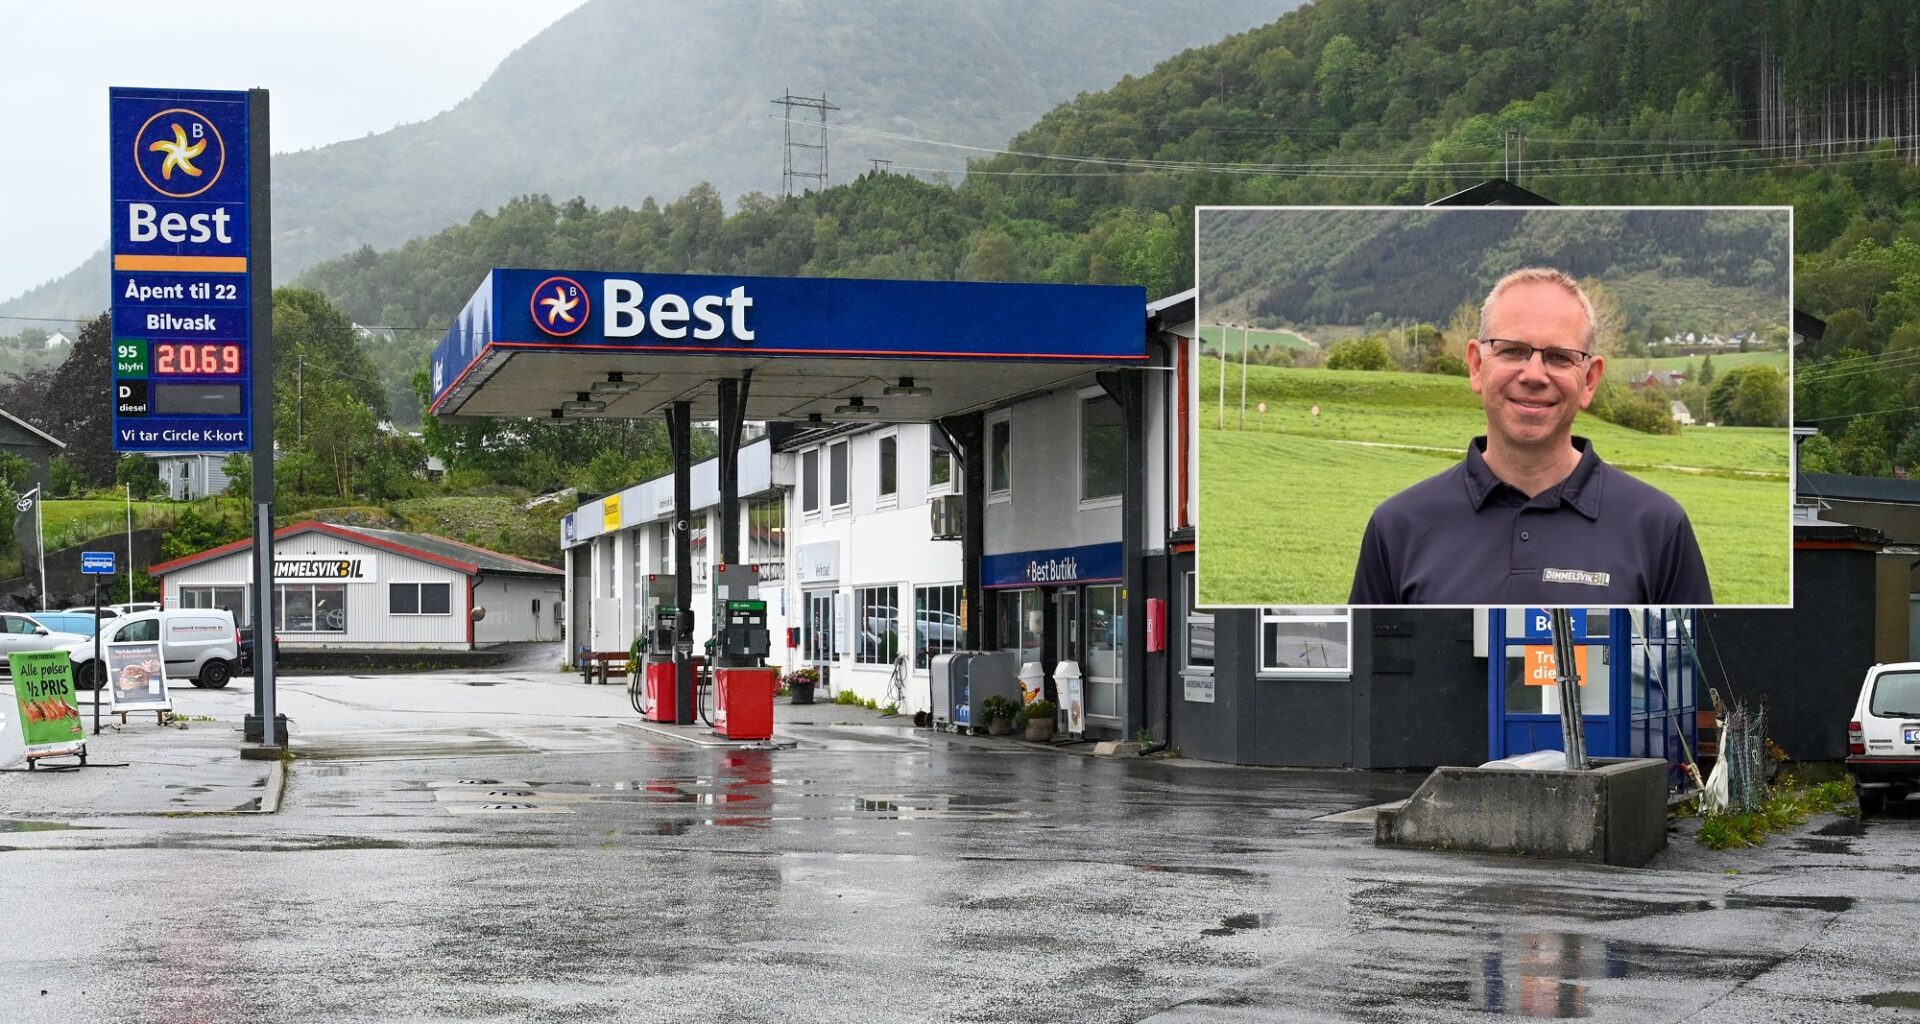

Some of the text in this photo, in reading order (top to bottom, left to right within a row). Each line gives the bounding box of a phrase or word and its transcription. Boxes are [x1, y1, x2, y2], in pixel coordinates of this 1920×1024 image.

[192, 123, 204, 138] B
[129, 203, 232, 244] Best
[125, 279, 237, 303] Åpent til 22
[569, 286, 577, 297] B
[603, 278, 755, 341] Best
[146, 313, 216, 331] Bilvask
[118, 345, 137, 359] 95
[158, 344, 240, 373] 20.69
[118, 361, 144, 373] blyfri
[118, 386, 131, 398] D
[119, 402, 147, 412] diesel
[121, 428, 244, 442] Vi tar Circle K-kort
[1031, 556, 1078, 582] Best Butikk
[21, 661, 70, 680] Alle pølser
[41, 678, 69, 697] PRIS
